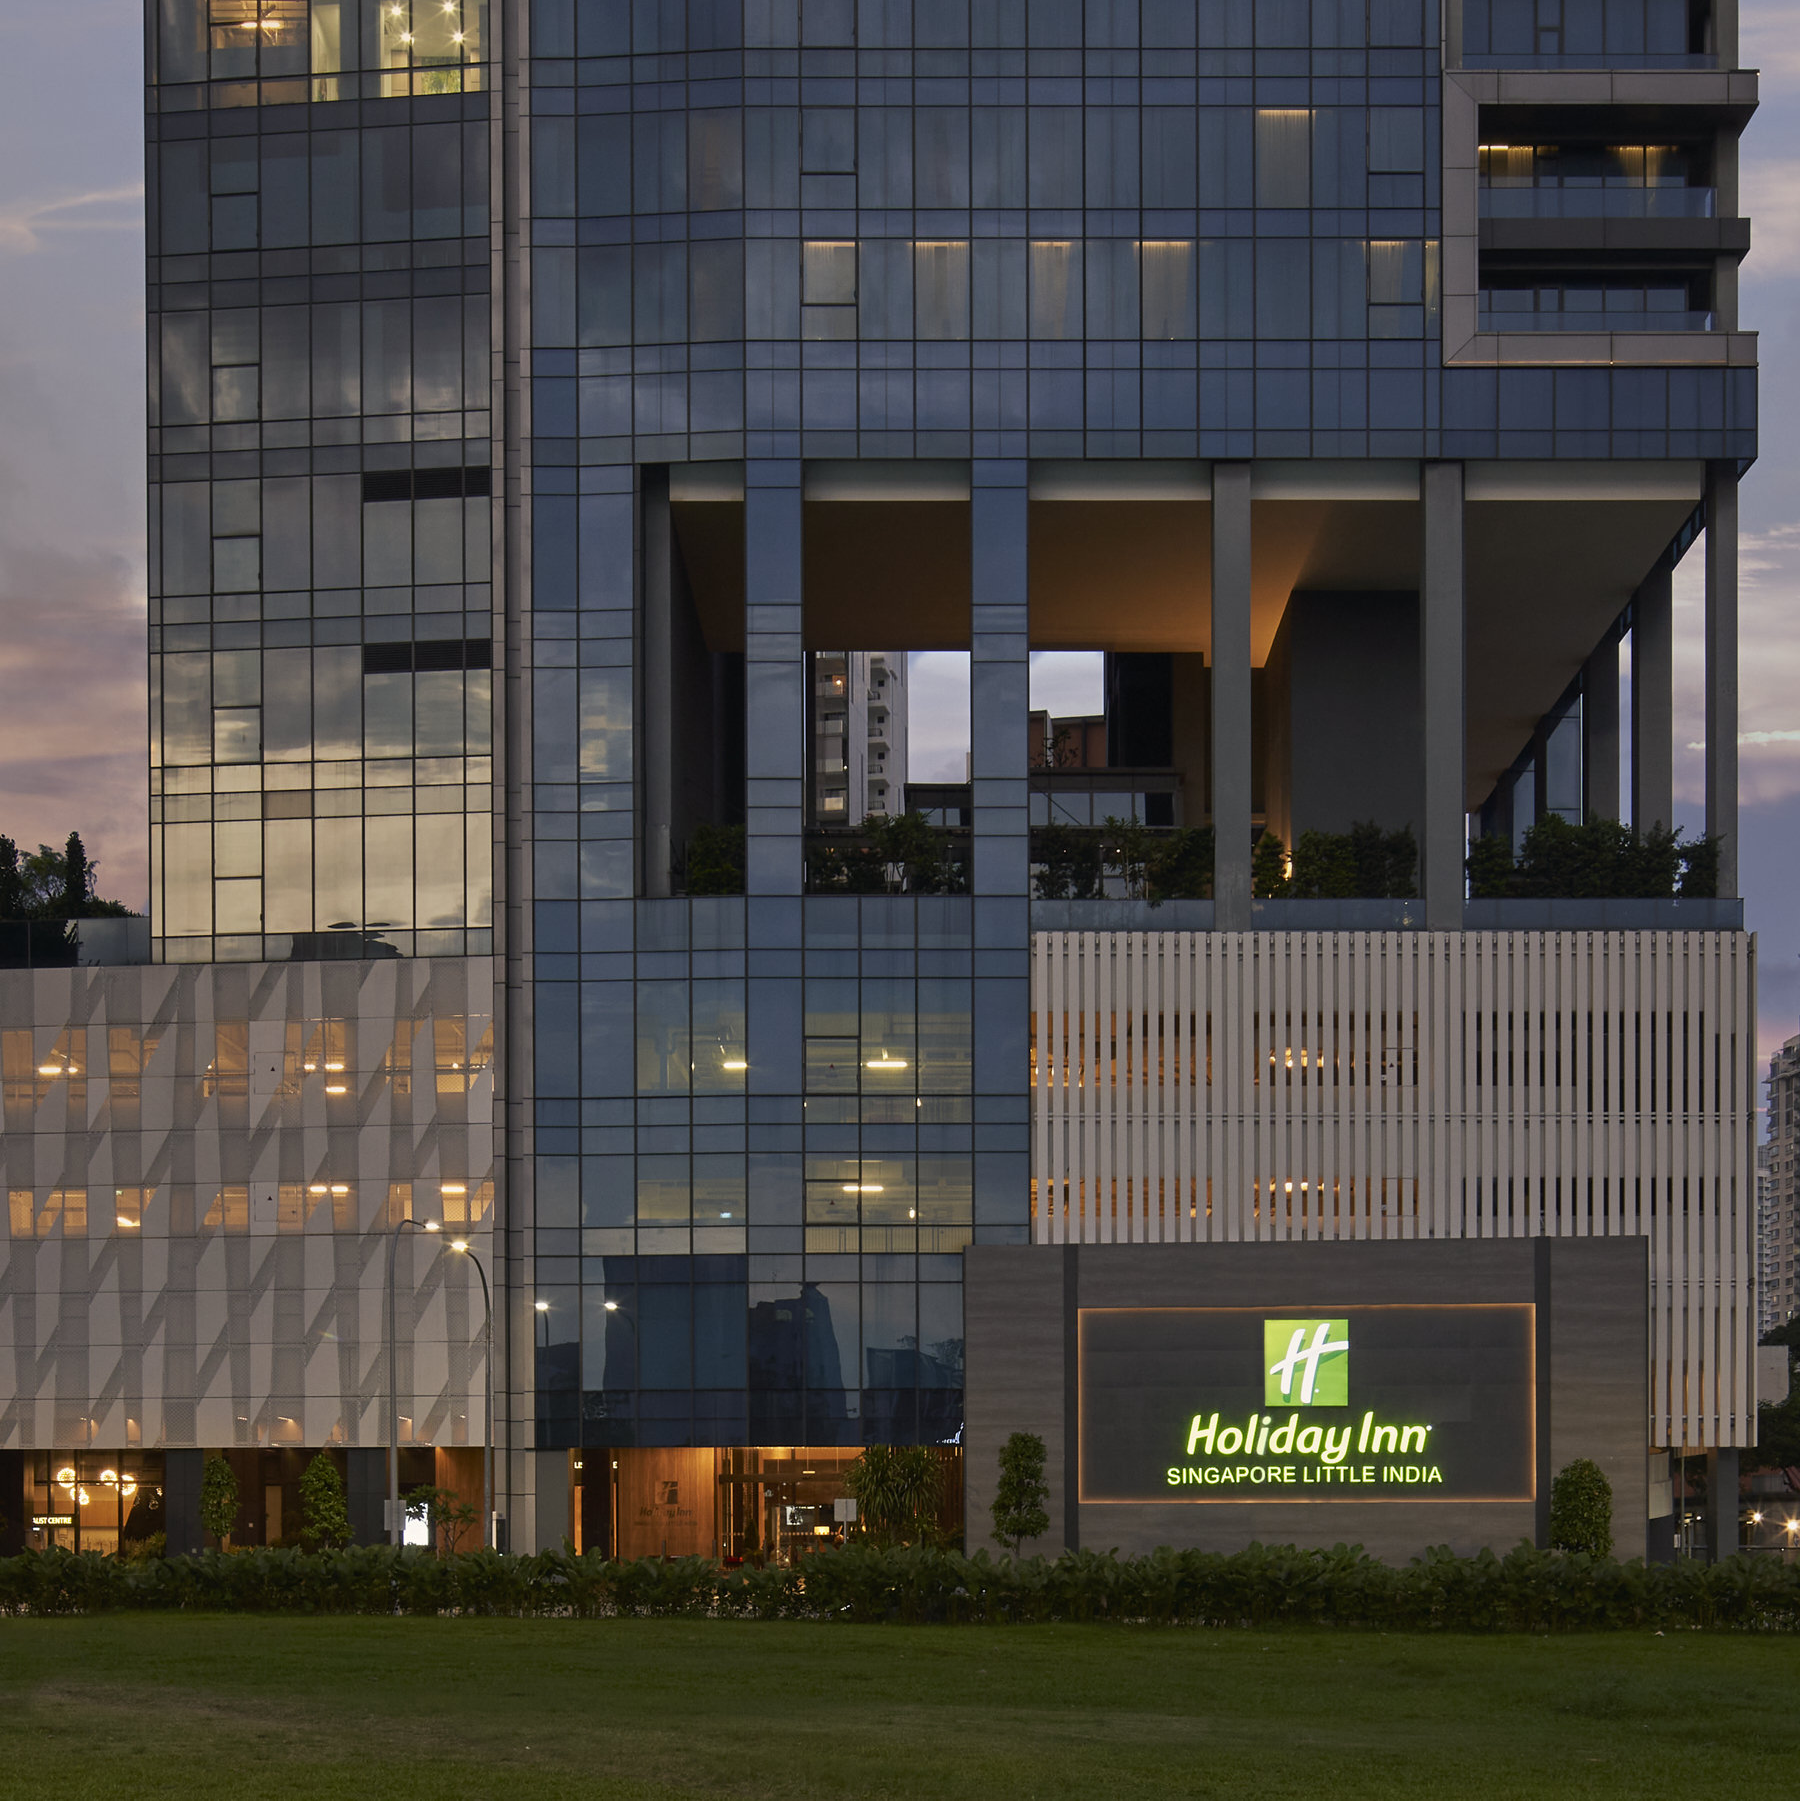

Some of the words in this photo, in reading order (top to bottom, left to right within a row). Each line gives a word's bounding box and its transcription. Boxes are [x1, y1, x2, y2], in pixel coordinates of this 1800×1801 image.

[1186, 1412, 1352, 1465] Holiday
[1357, 1410, 1428, 1454] Inn
[1167, 1465, 1297, 1485] SINGAPORE
[1303, 1465, 1376, 1483] LITTLE
[1382, 1465, 1443, 1483] INDIA
[47, 1516, 72, 1524] CENTRE
